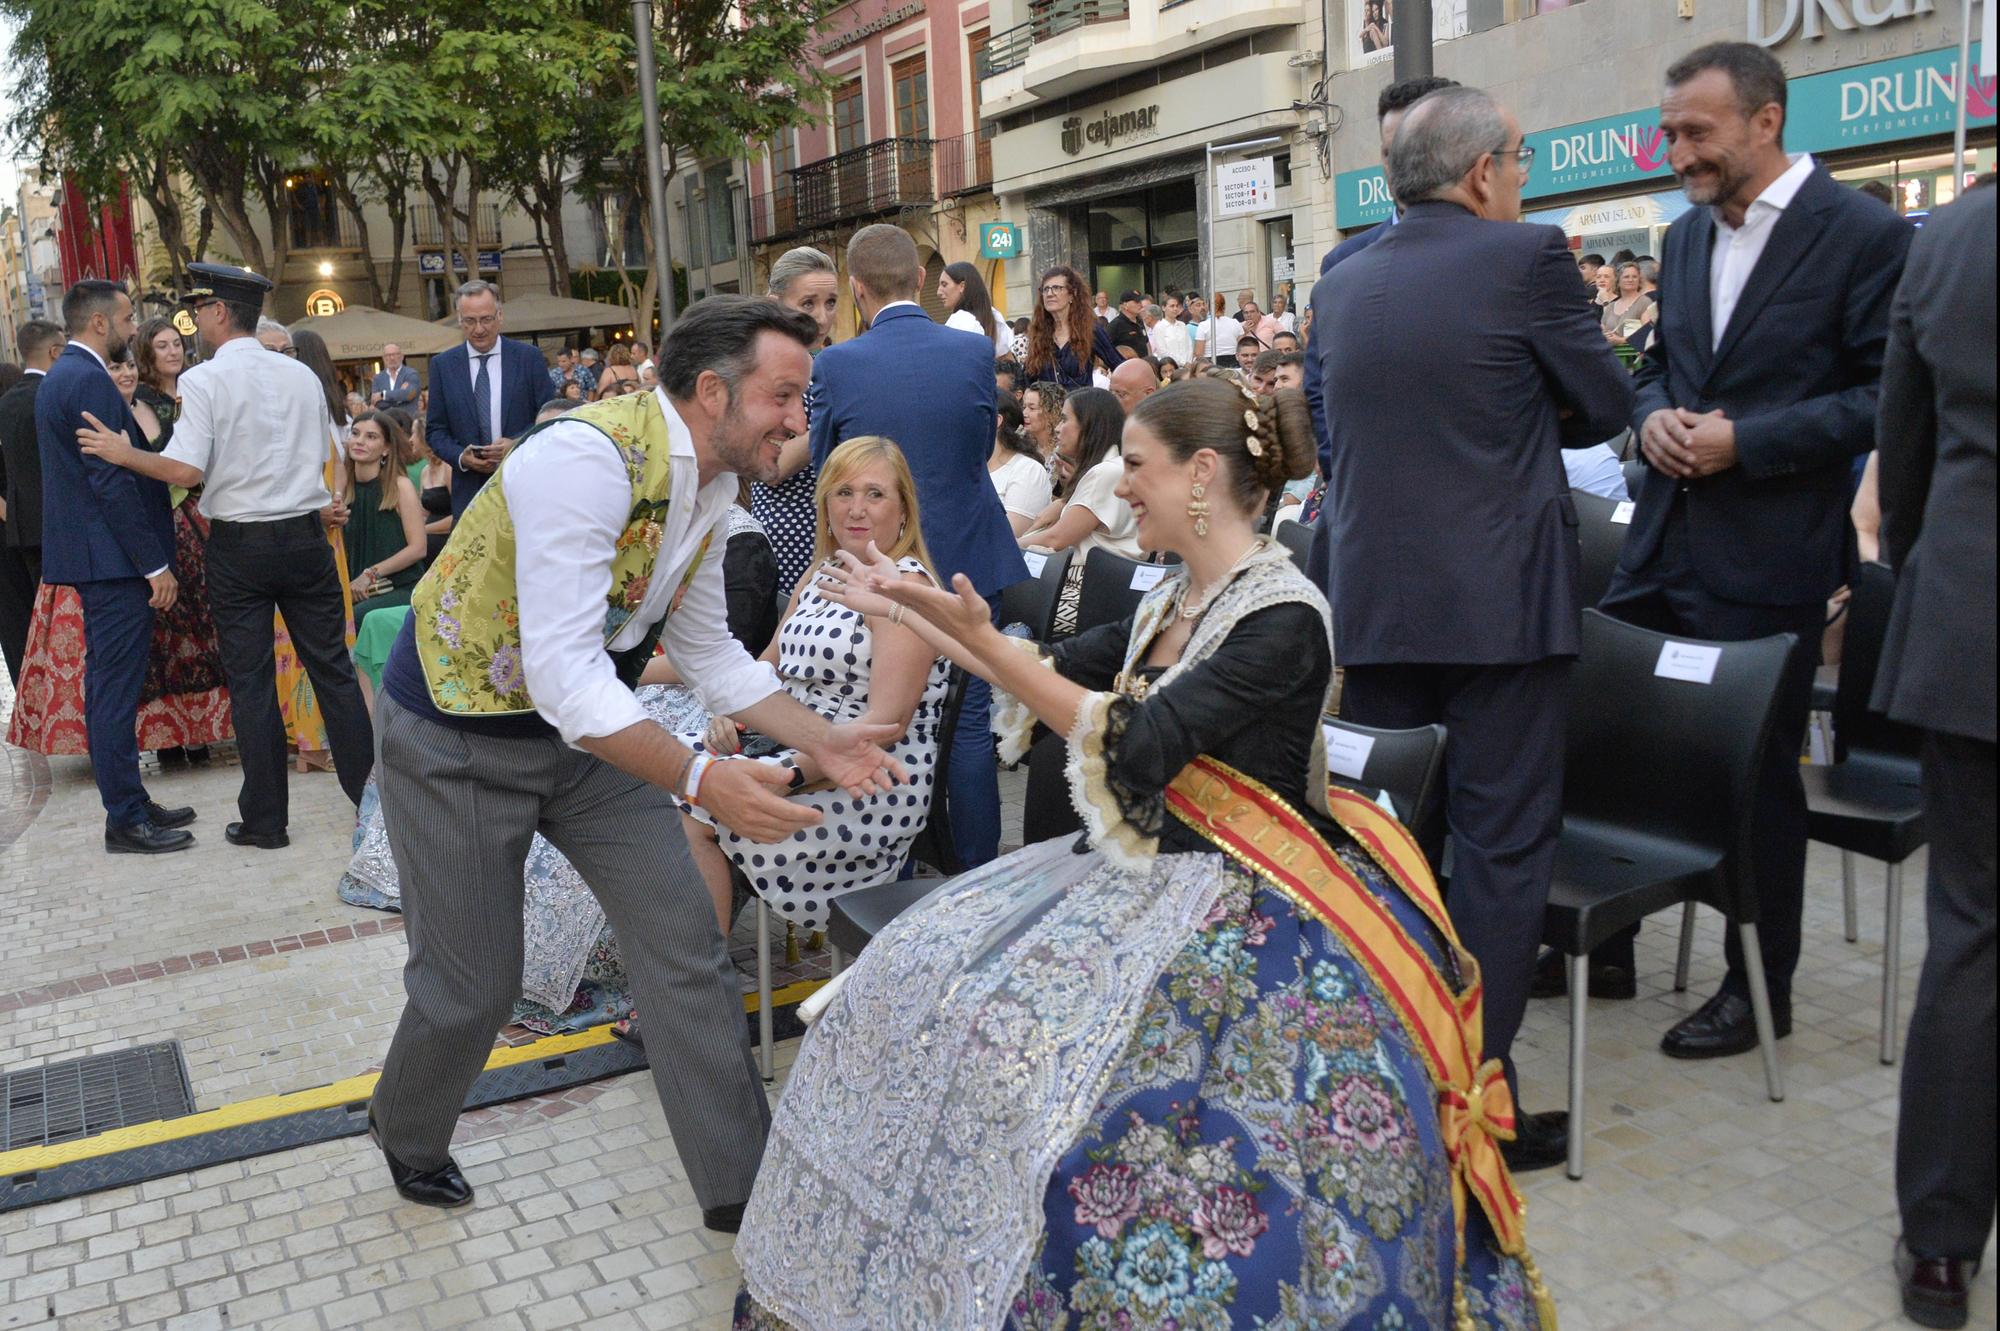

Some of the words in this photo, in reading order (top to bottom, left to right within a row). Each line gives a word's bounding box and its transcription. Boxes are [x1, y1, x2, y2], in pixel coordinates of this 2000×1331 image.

[1840, 61, 1958, 121] DRUN
[1086, 104, 1159, 148] cajamar
[1841, 111, 1951, 136] PERFUMERIE
[1551, 124, 1638, 171] DRUNI
[1553, 164, 1635, 184] PERFUMERIES
[1580, 211, 1611, 226] ARMANI
[1613, 206, 1646, 223] ISLAND
